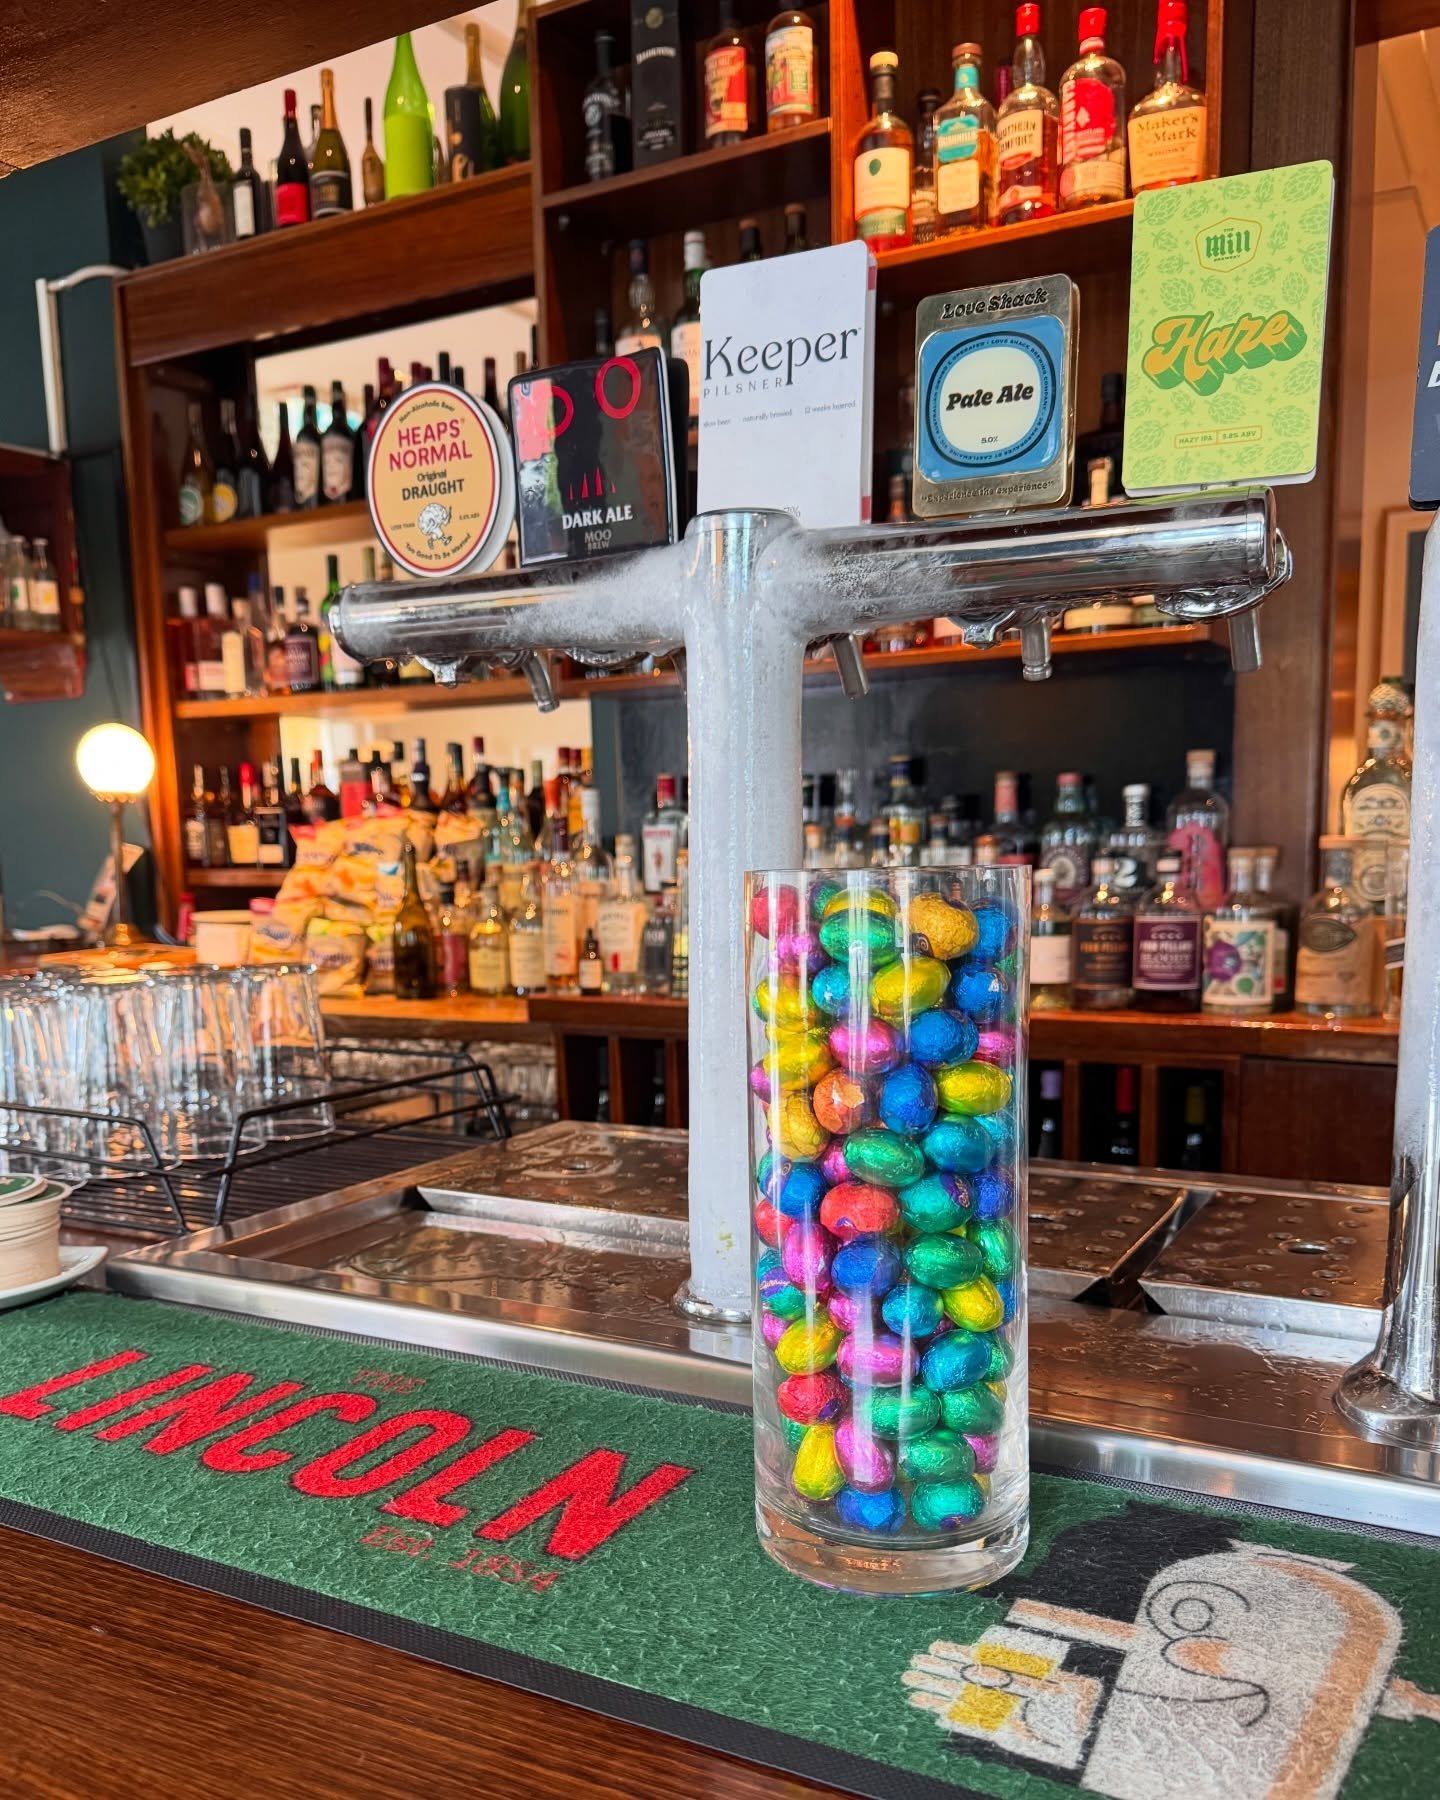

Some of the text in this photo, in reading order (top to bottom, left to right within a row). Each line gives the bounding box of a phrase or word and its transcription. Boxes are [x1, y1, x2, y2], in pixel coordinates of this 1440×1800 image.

[1154, 127, 1197, 142] Mark
[941, 287, 1049, 320] Love Shack
[704, 327, 859, 386] Keeper
[1141, 310, 1308, 396] Haze
[702, 376, 782, 399] PILSNER
[945, 383, 1035, 411] Pale Ale
[398, 418, 461, 448] HEAPS
[389, 439, 473, 472] NORMAL
[416, 469, 448, 483] Original
[401, 478, 465, 502] DRAUGHT
[561, 504, 634, 530] DARK ALE
[584, 529, 613, 544] MOO
[587, 540, 611, 551] BREW
[350, 1368, 427, 1395] THE
[0, 1350, 698, 1562] LINCOLN
[448, 1548, 561, 1592] 1854
